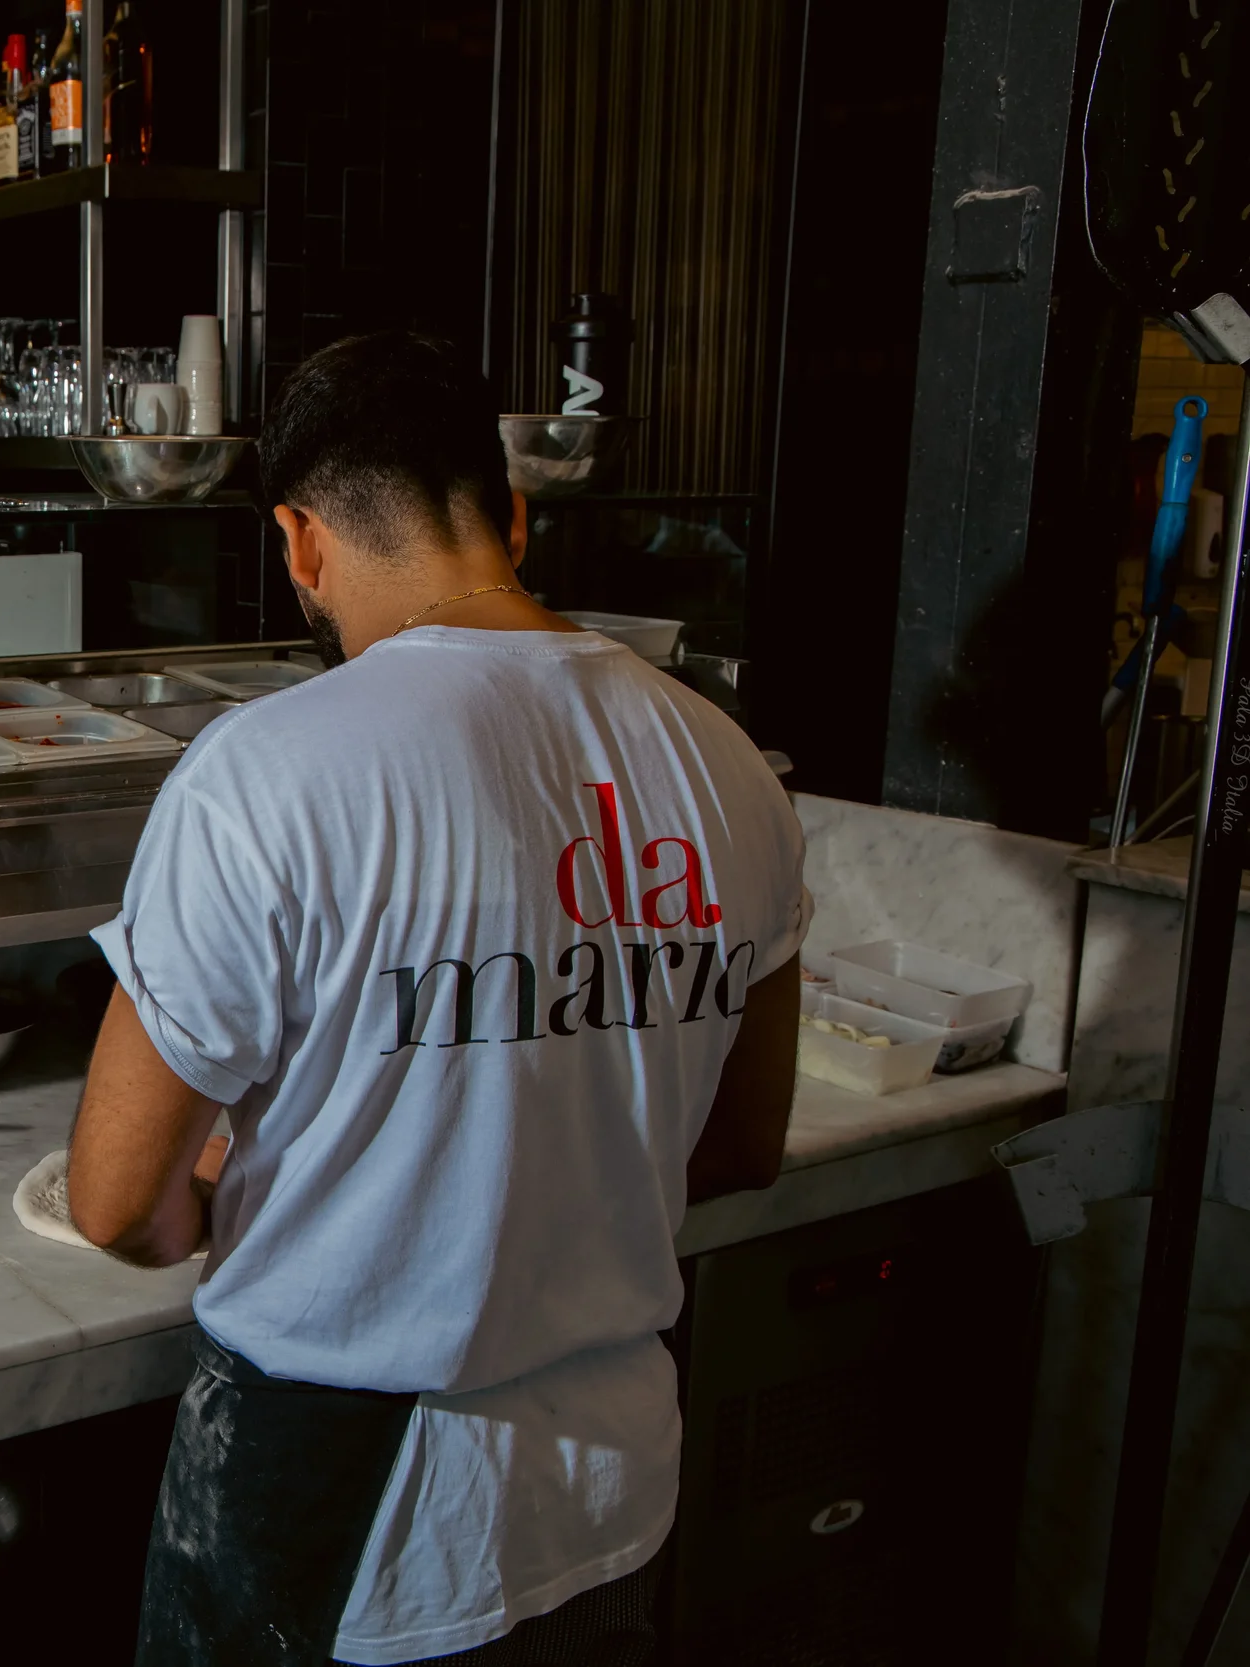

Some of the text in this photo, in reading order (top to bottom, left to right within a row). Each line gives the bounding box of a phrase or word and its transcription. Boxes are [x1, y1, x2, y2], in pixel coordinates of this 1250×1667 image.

[556, 782, 722, 929] da
[1223, 775, 1249, 835] Italia
[379, 940, 755, 1055] mario
